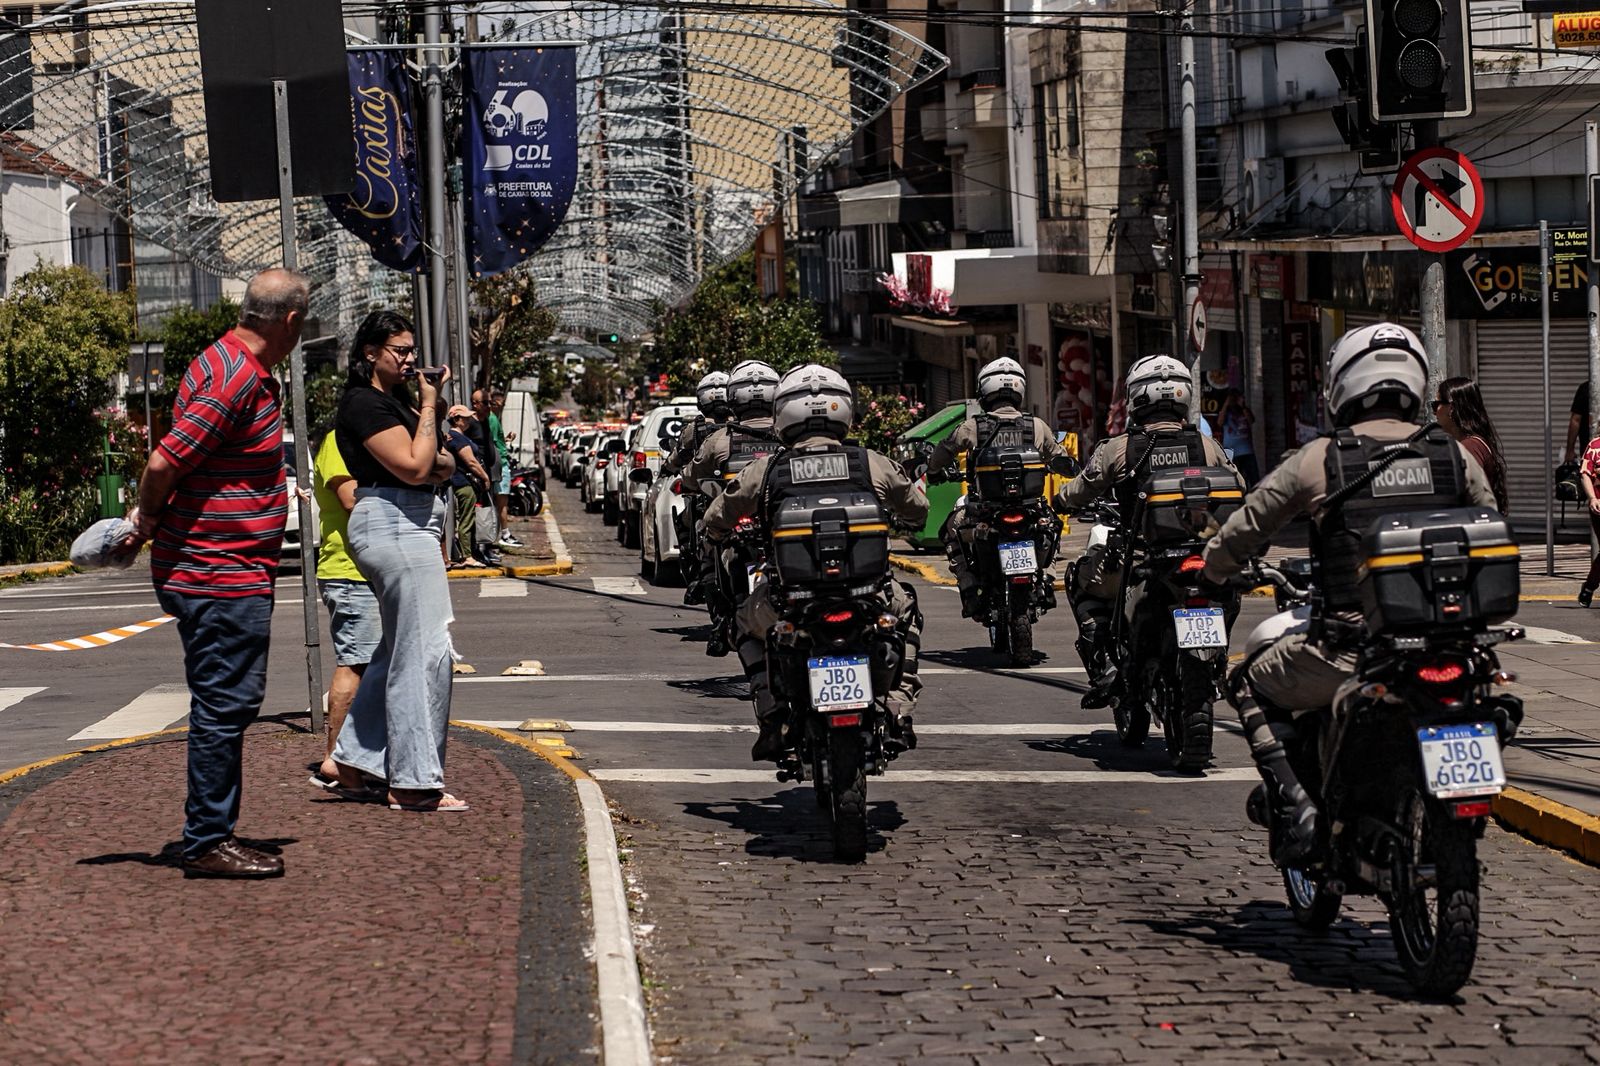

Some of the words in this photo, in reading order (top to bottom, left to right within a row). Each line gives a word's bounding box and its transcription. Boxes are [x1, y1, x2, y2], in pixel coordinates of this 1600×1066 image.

[1557, 17, 1600, 32] ALUG
[514, 145, 552, 161] CDL
[498, 182, 552, 192] PREFEITURA
[1554, 231, 1566, 240] Dr.
[1366, 265, 1394, 288] GOLDEN
[1151, 452, 1187, 466] ROCAM
[794, 457, 846, 480] ROCAM
[1374, 467, 1430, 487] ROCAM
[1007, 549, 1027, 560] JBO
[1005, 558, 1033, 570] 6G35
[1185, 617, 1214, 631] TQP
[1184, 630, 1221, 645] 4H31
[824, 668, 856, 685] JBO
[820, 684, 864, 702] 6G26
[1443, 731, 1472, 739] BRASIL
[1441, 740, 1482, 763] JBO
